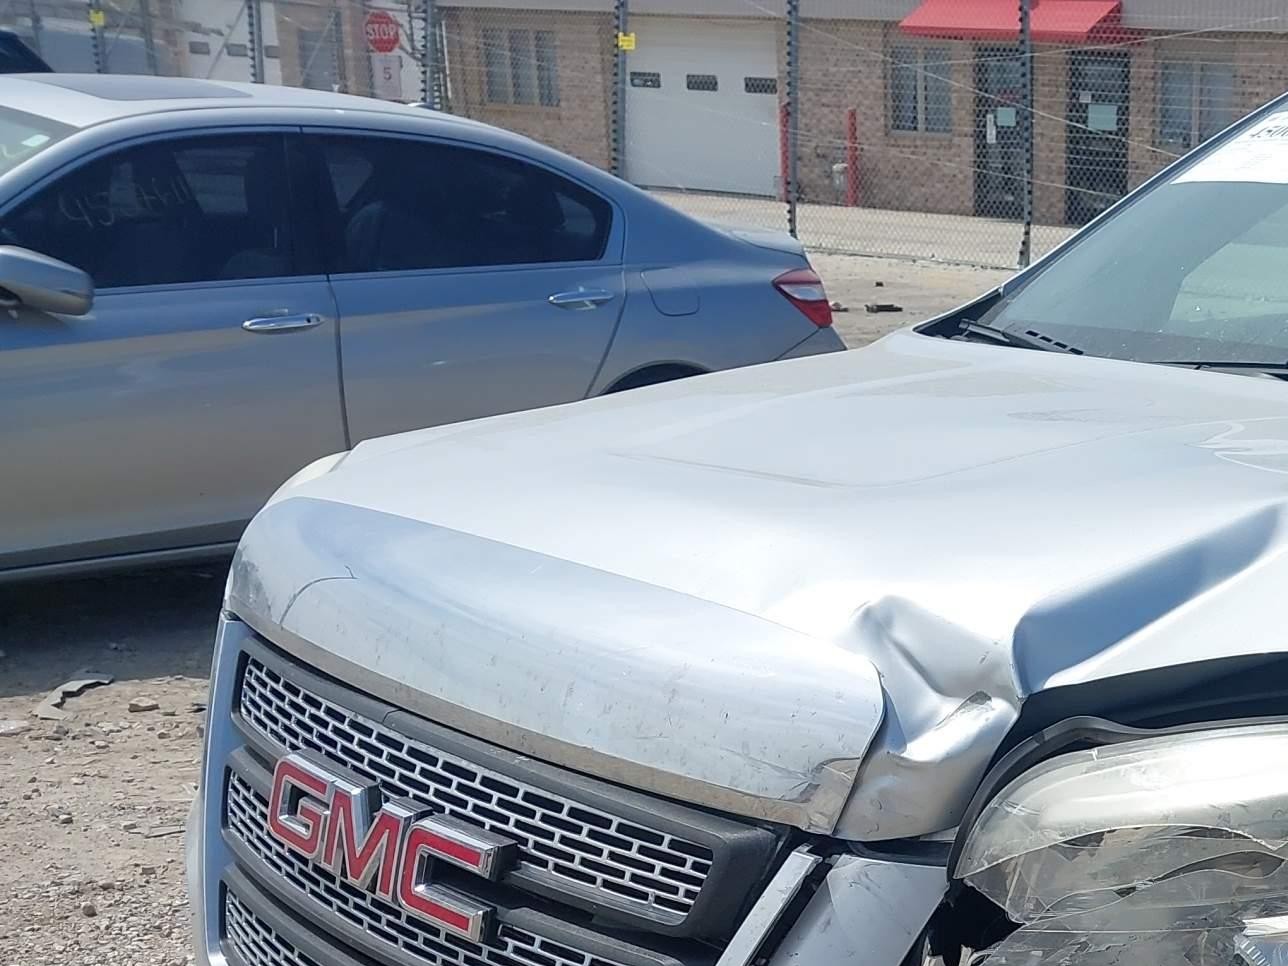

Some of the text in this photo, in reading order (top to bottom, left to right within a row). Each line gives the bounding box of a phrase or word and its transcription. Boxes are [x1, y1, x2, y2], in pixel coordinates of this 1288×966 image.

[366, 23, 397, 39] STOP
[383, 66, 393, 81] 5
[267, 752, 496, 944] GMC
